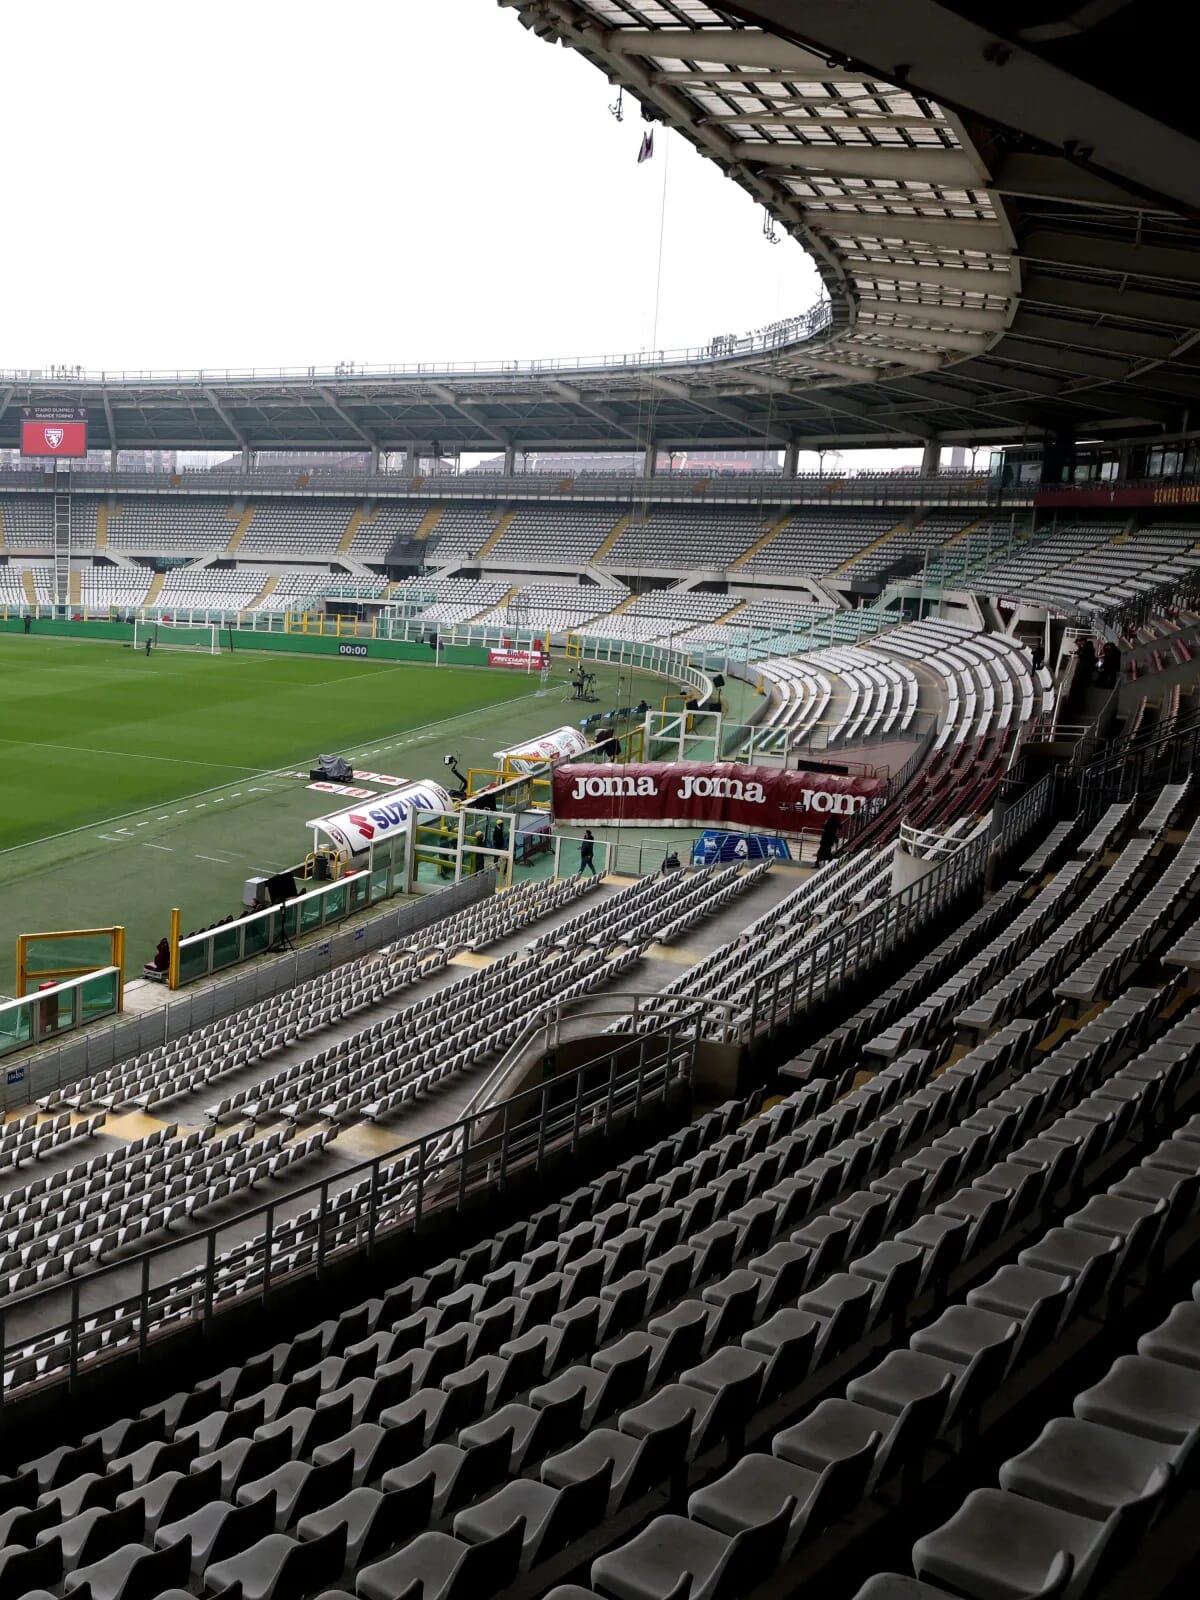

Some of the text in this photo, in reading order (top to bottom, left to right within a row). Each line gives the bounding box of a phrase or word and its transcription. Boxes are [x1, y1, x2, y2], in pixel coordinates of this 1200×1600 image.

[340, 645, 367, 655] 00:00
[572, 775, 658, 800] Joma
[678, 775, 766, 804] Joma
